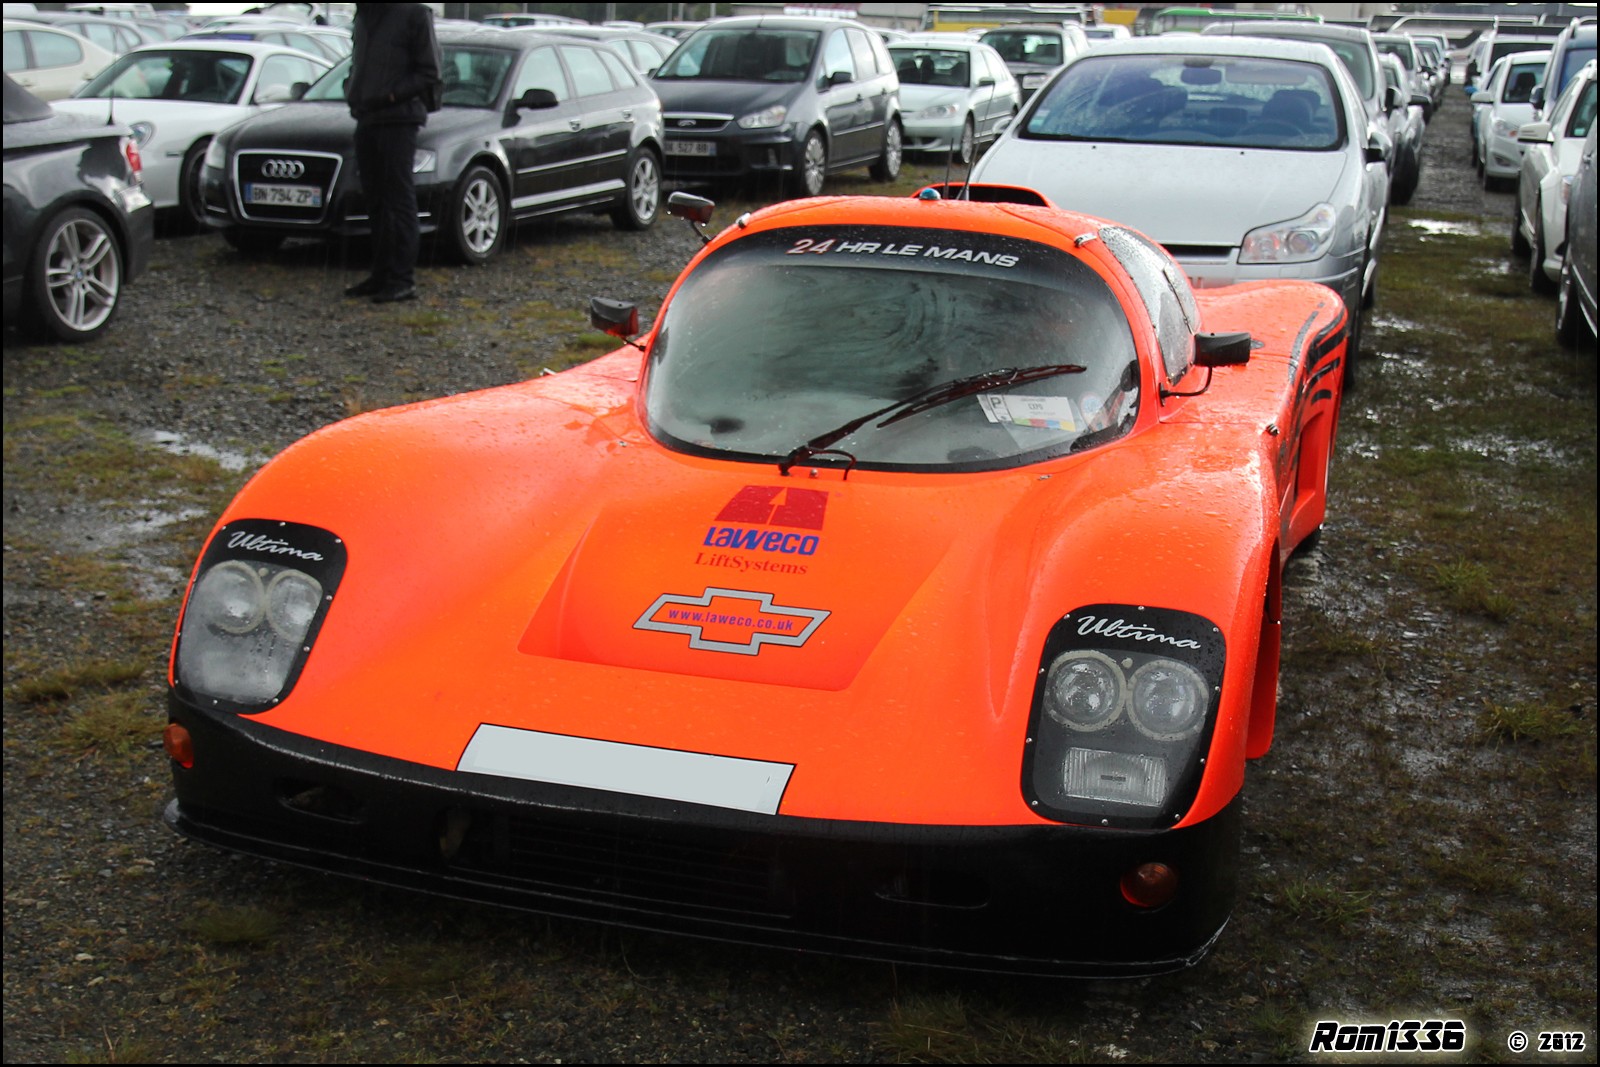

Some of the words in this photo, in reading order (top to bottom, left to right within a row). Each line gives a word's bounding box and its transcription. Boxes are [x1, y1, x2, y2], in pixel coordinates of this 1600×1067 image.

[296, 189, 313, 203] ZP
[787, 239, 836, 255] 24
[835, 241, 882, 255] HR
[882, 243, 923, 256] LE
[924, 246, 1019, 268] MANS
[990, 396, 1002, 409] P
[227, 531, 324, 561] Ultima
[694, 552, 808, 575] LiftSystems
[668, 609, 793, 631] www.laweco.co.uk
[1077, 615, 1201, 649] Ultima
